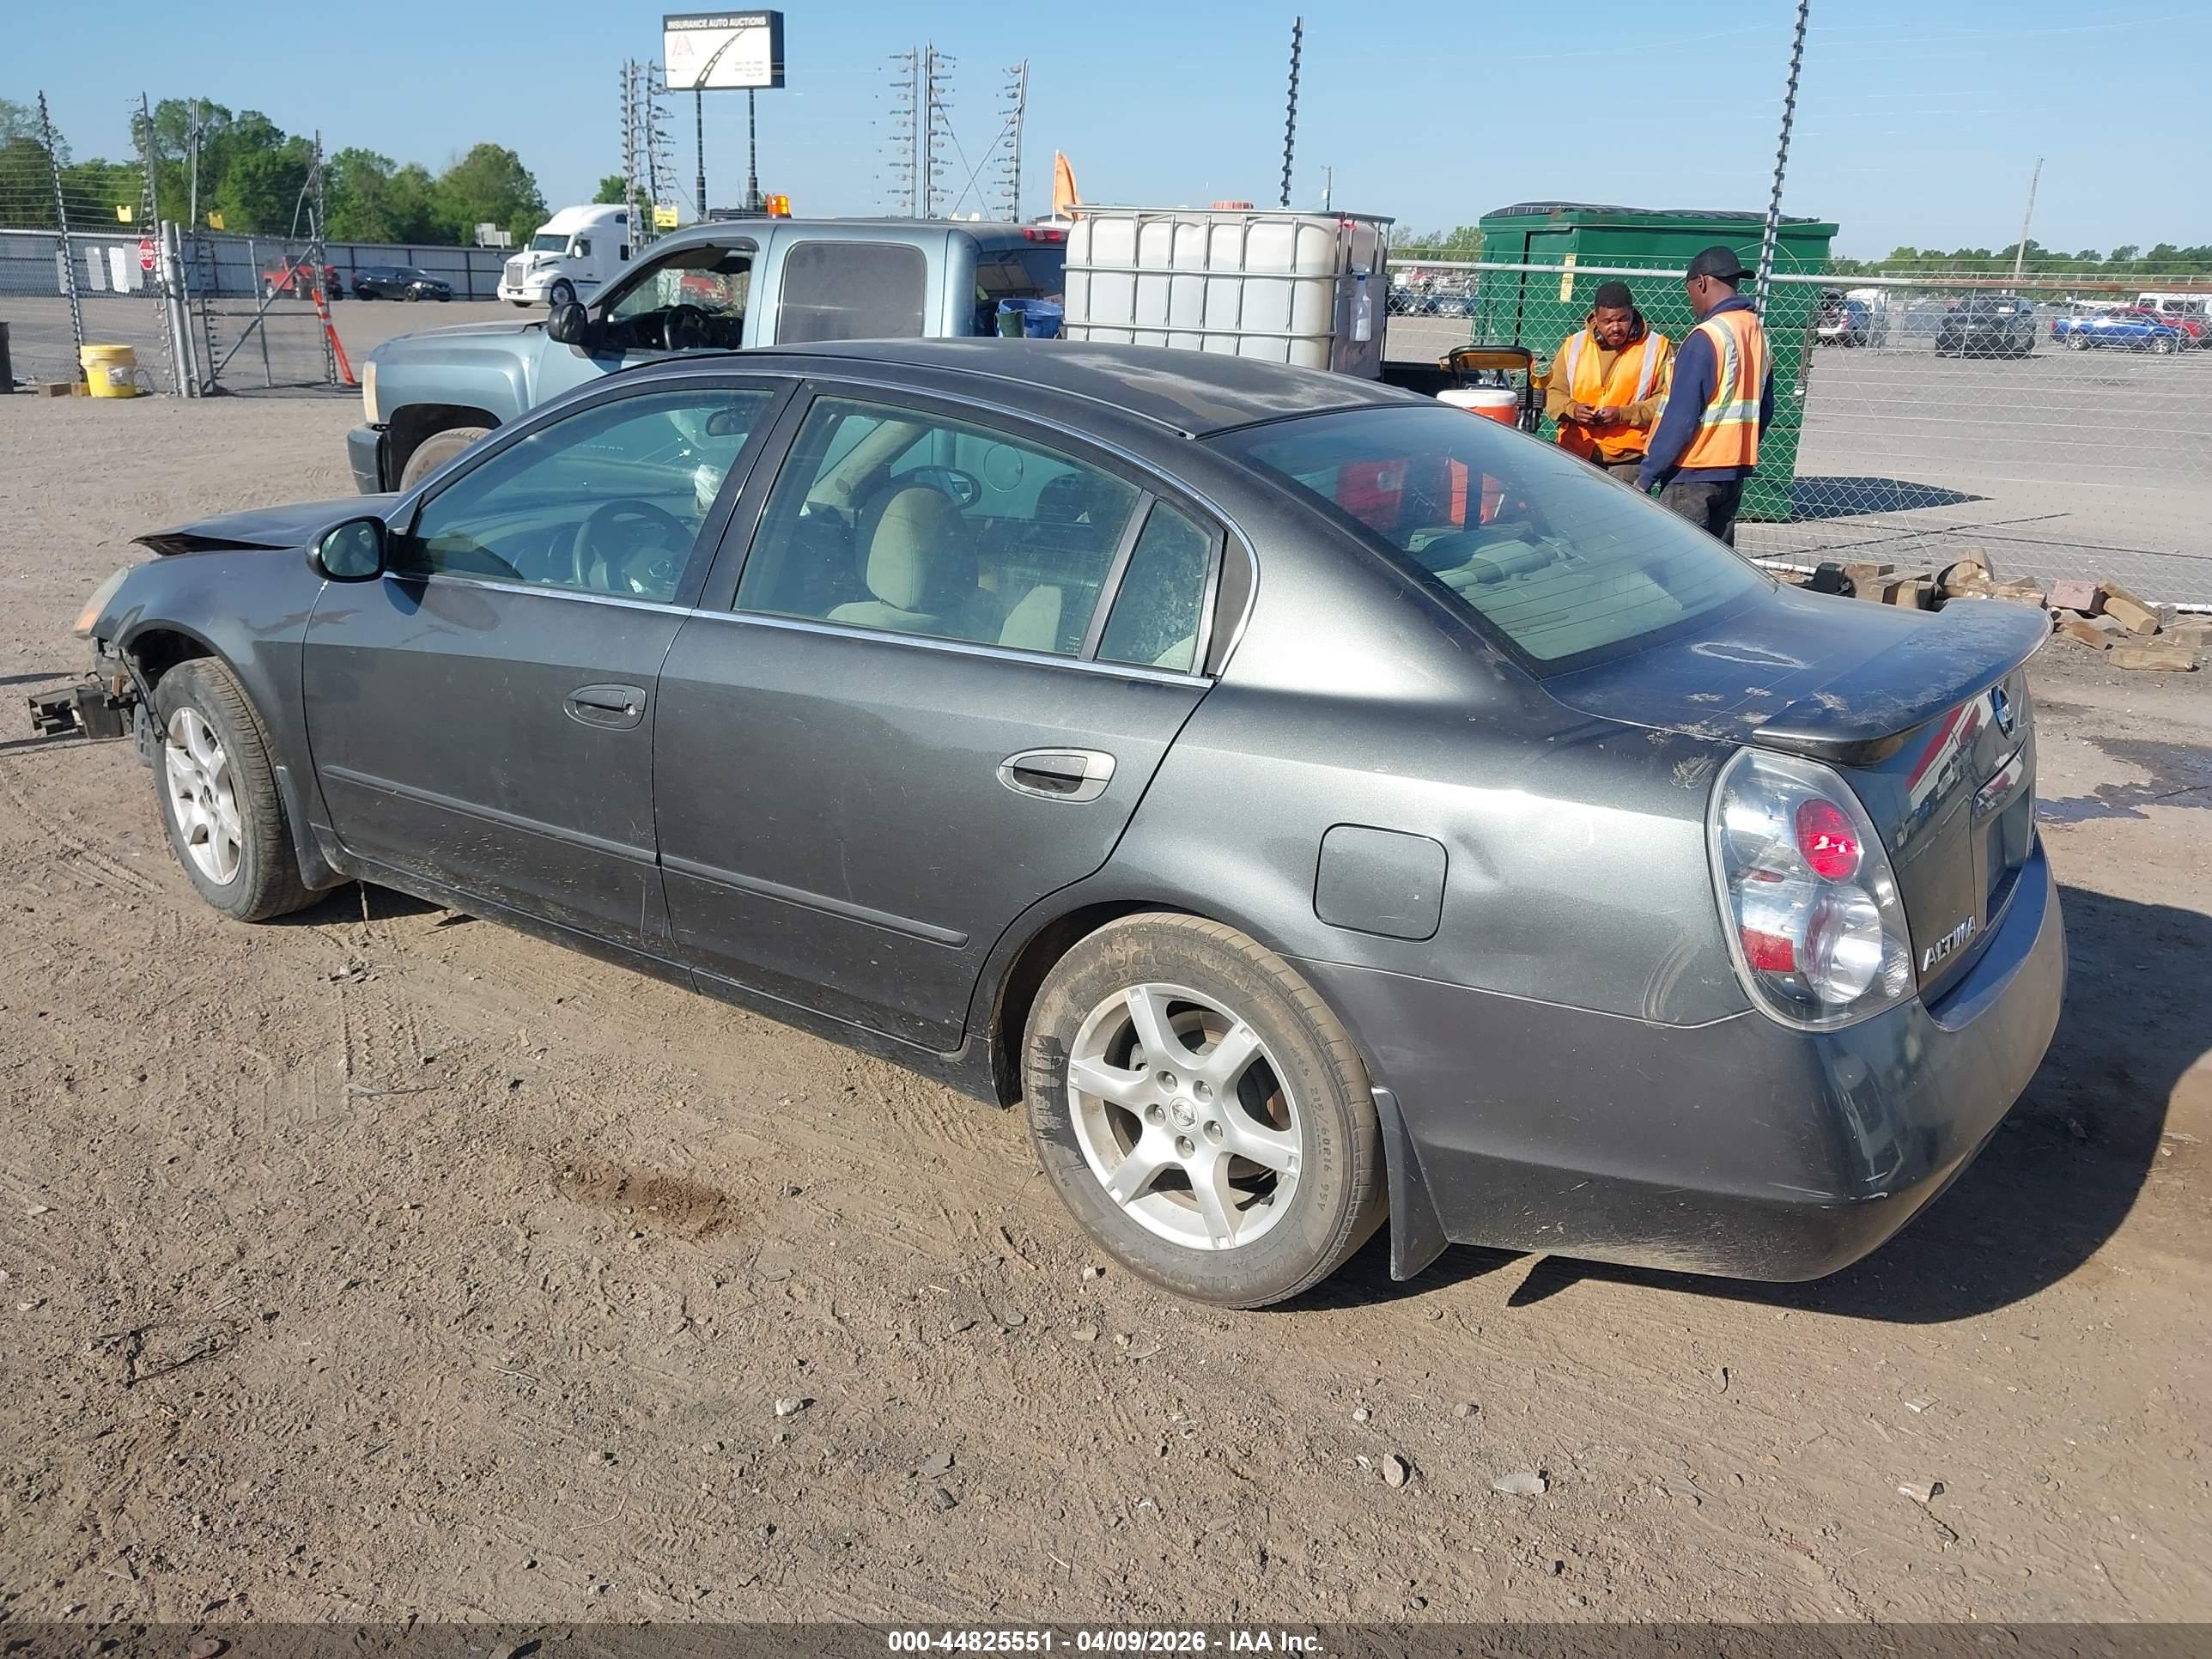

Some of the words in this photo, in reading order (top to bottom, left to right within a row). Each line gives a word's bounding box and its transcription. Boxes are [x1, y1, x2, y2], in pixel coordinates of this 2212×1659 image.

[666, 19, 708, 29] INSURANCE
[708, 18, 728, 27] AUTO
[729, 16, 766, 27] AUCTIONS
[1923, 915, 1976, 971] ALTIMA
